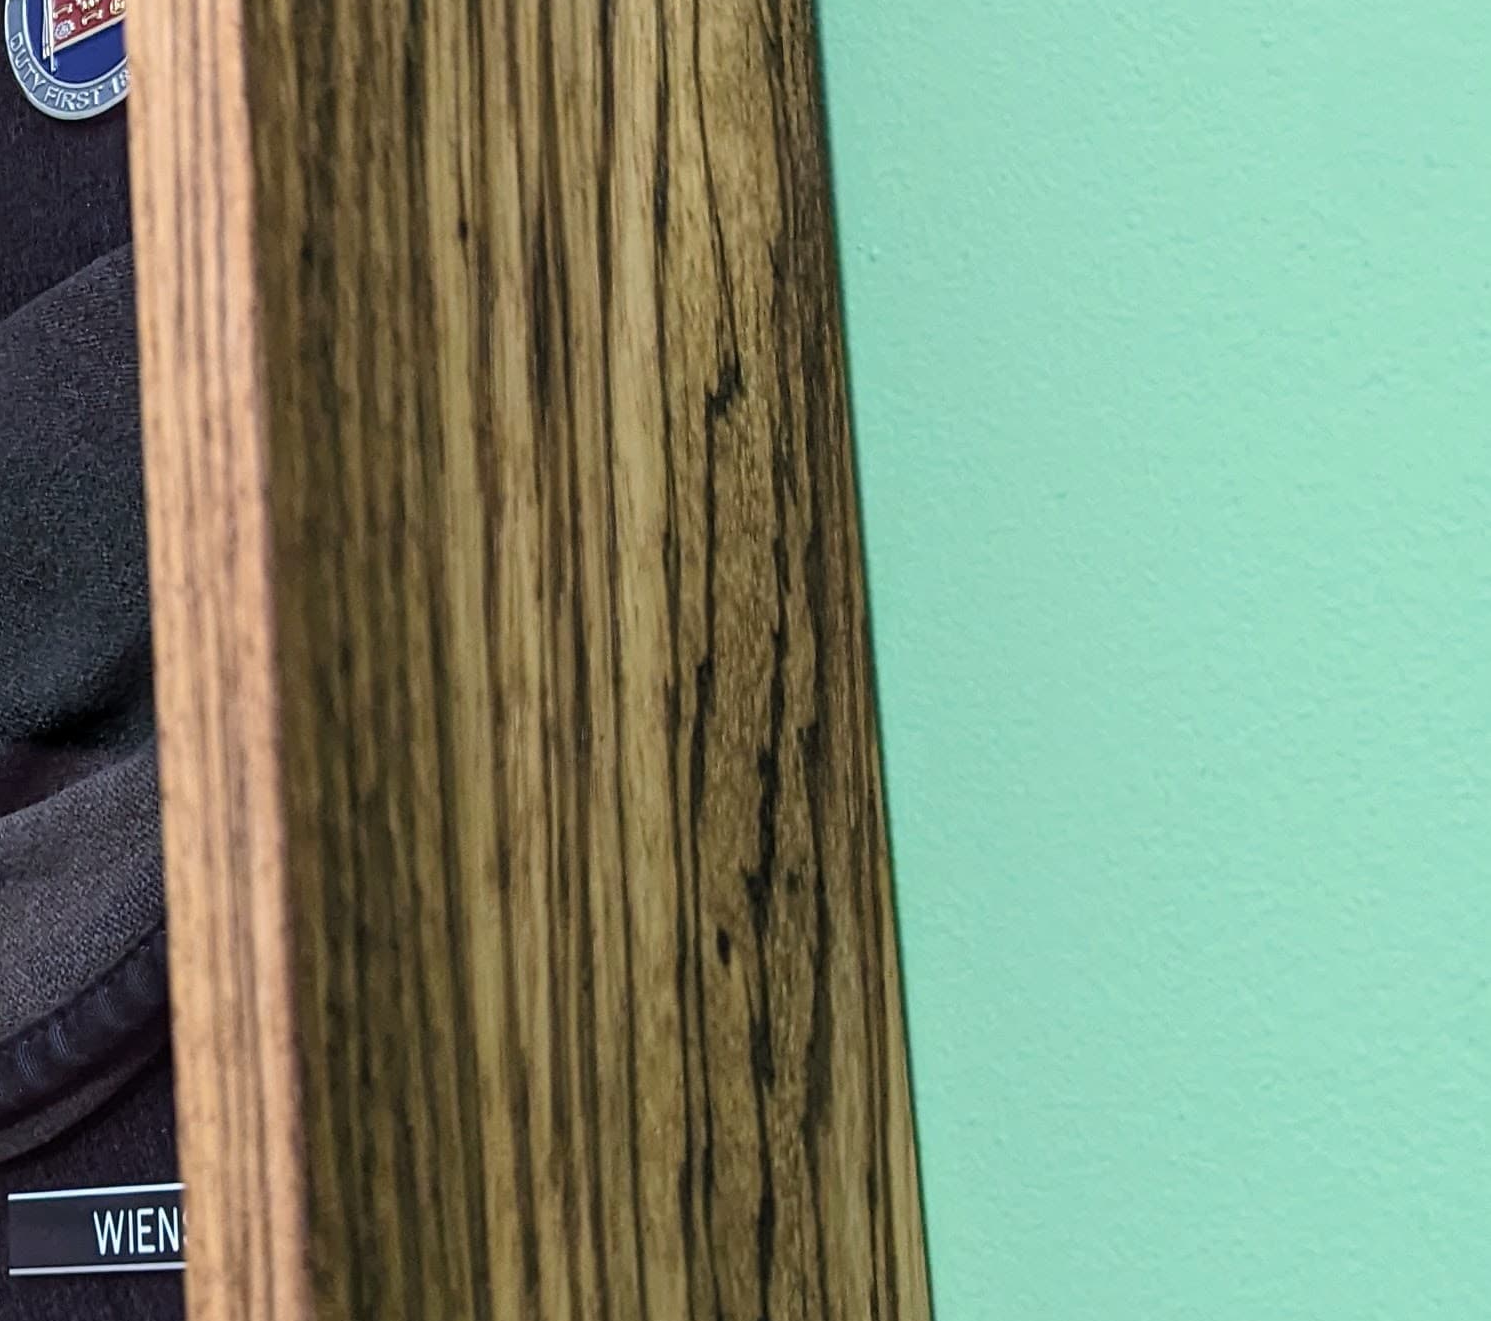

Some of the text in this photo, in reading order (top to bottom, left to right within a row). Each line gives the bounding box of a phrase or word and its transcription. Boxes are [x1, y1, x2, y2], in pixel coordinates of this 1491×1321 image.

[10, 32, 46, 94] DUTY
[44, 84, 104, 112] FIRST
[93, 1206, 188, 1257] WIEN
